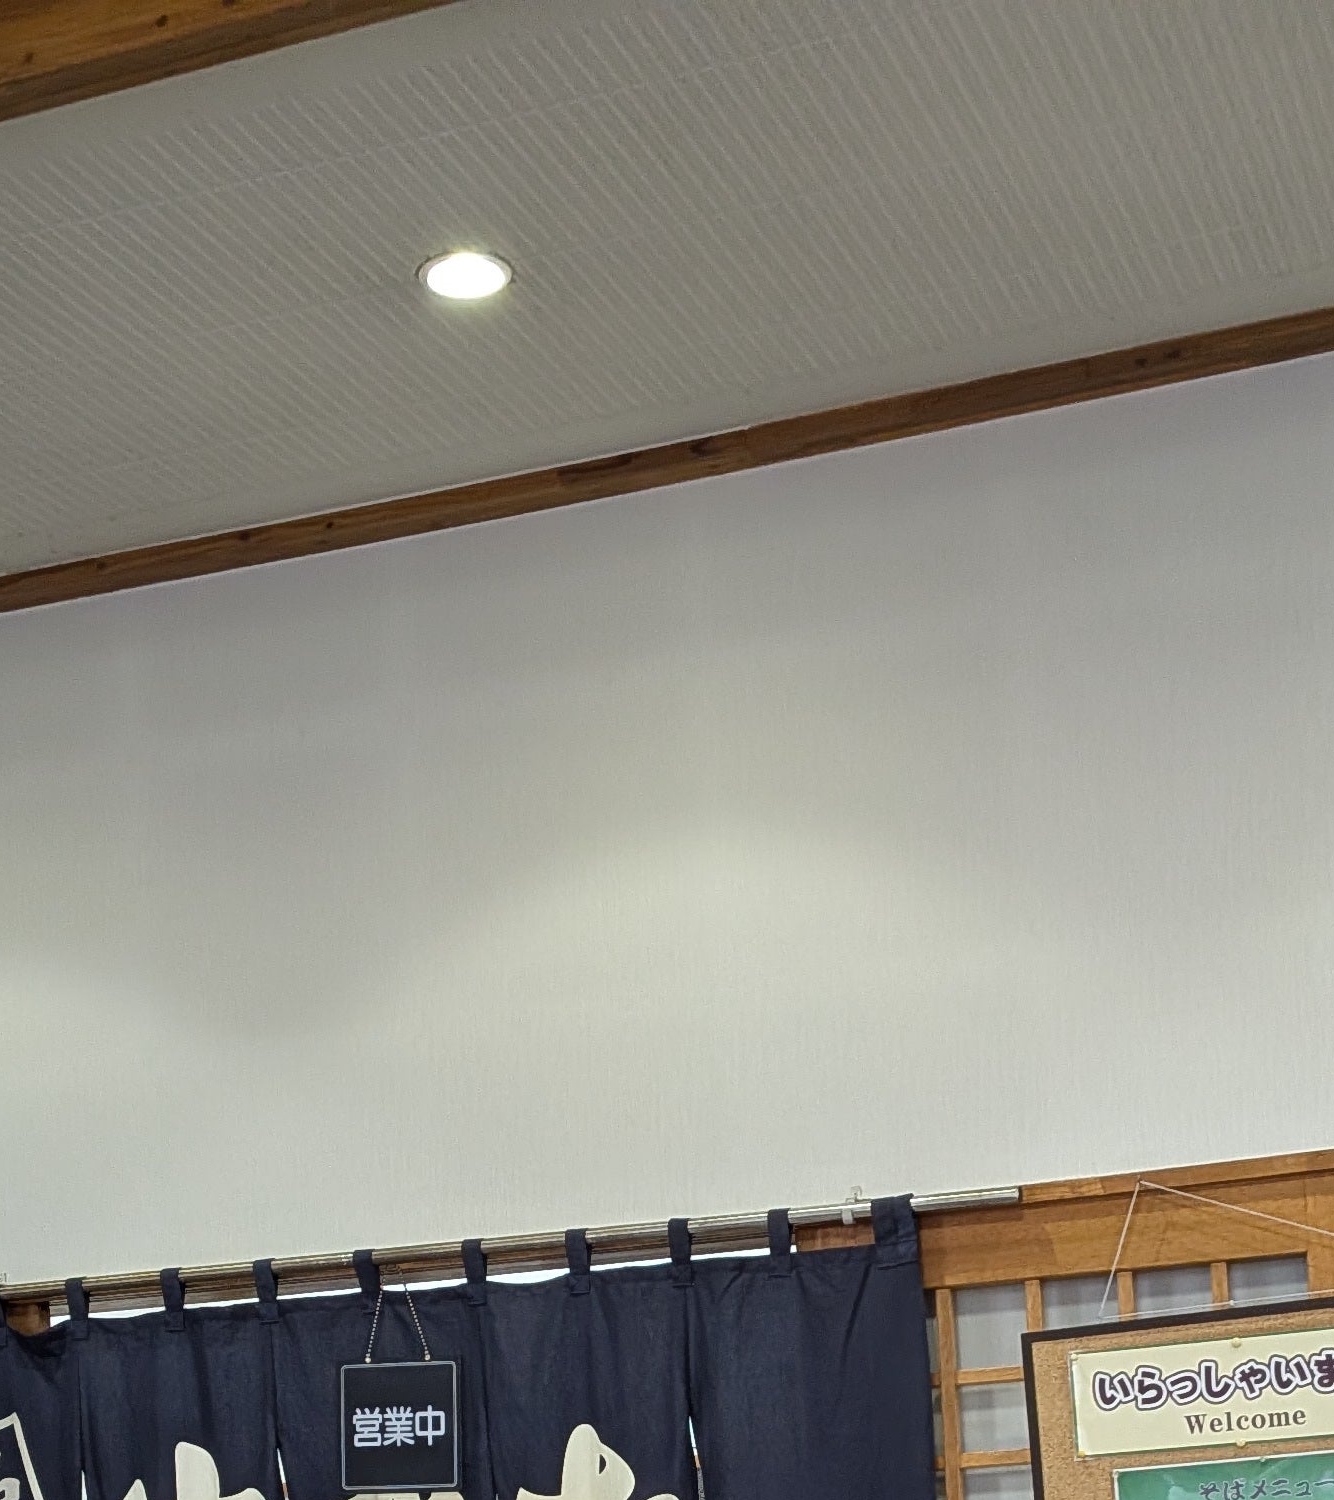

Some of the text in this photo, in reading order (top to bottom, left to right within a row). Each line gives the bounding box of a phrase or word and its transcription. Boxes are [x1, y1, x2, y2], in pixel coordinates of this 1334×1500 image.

[352, 1404, 446, 1448] 営業中
[1184, 1409, 1307, 1435] Welcome
